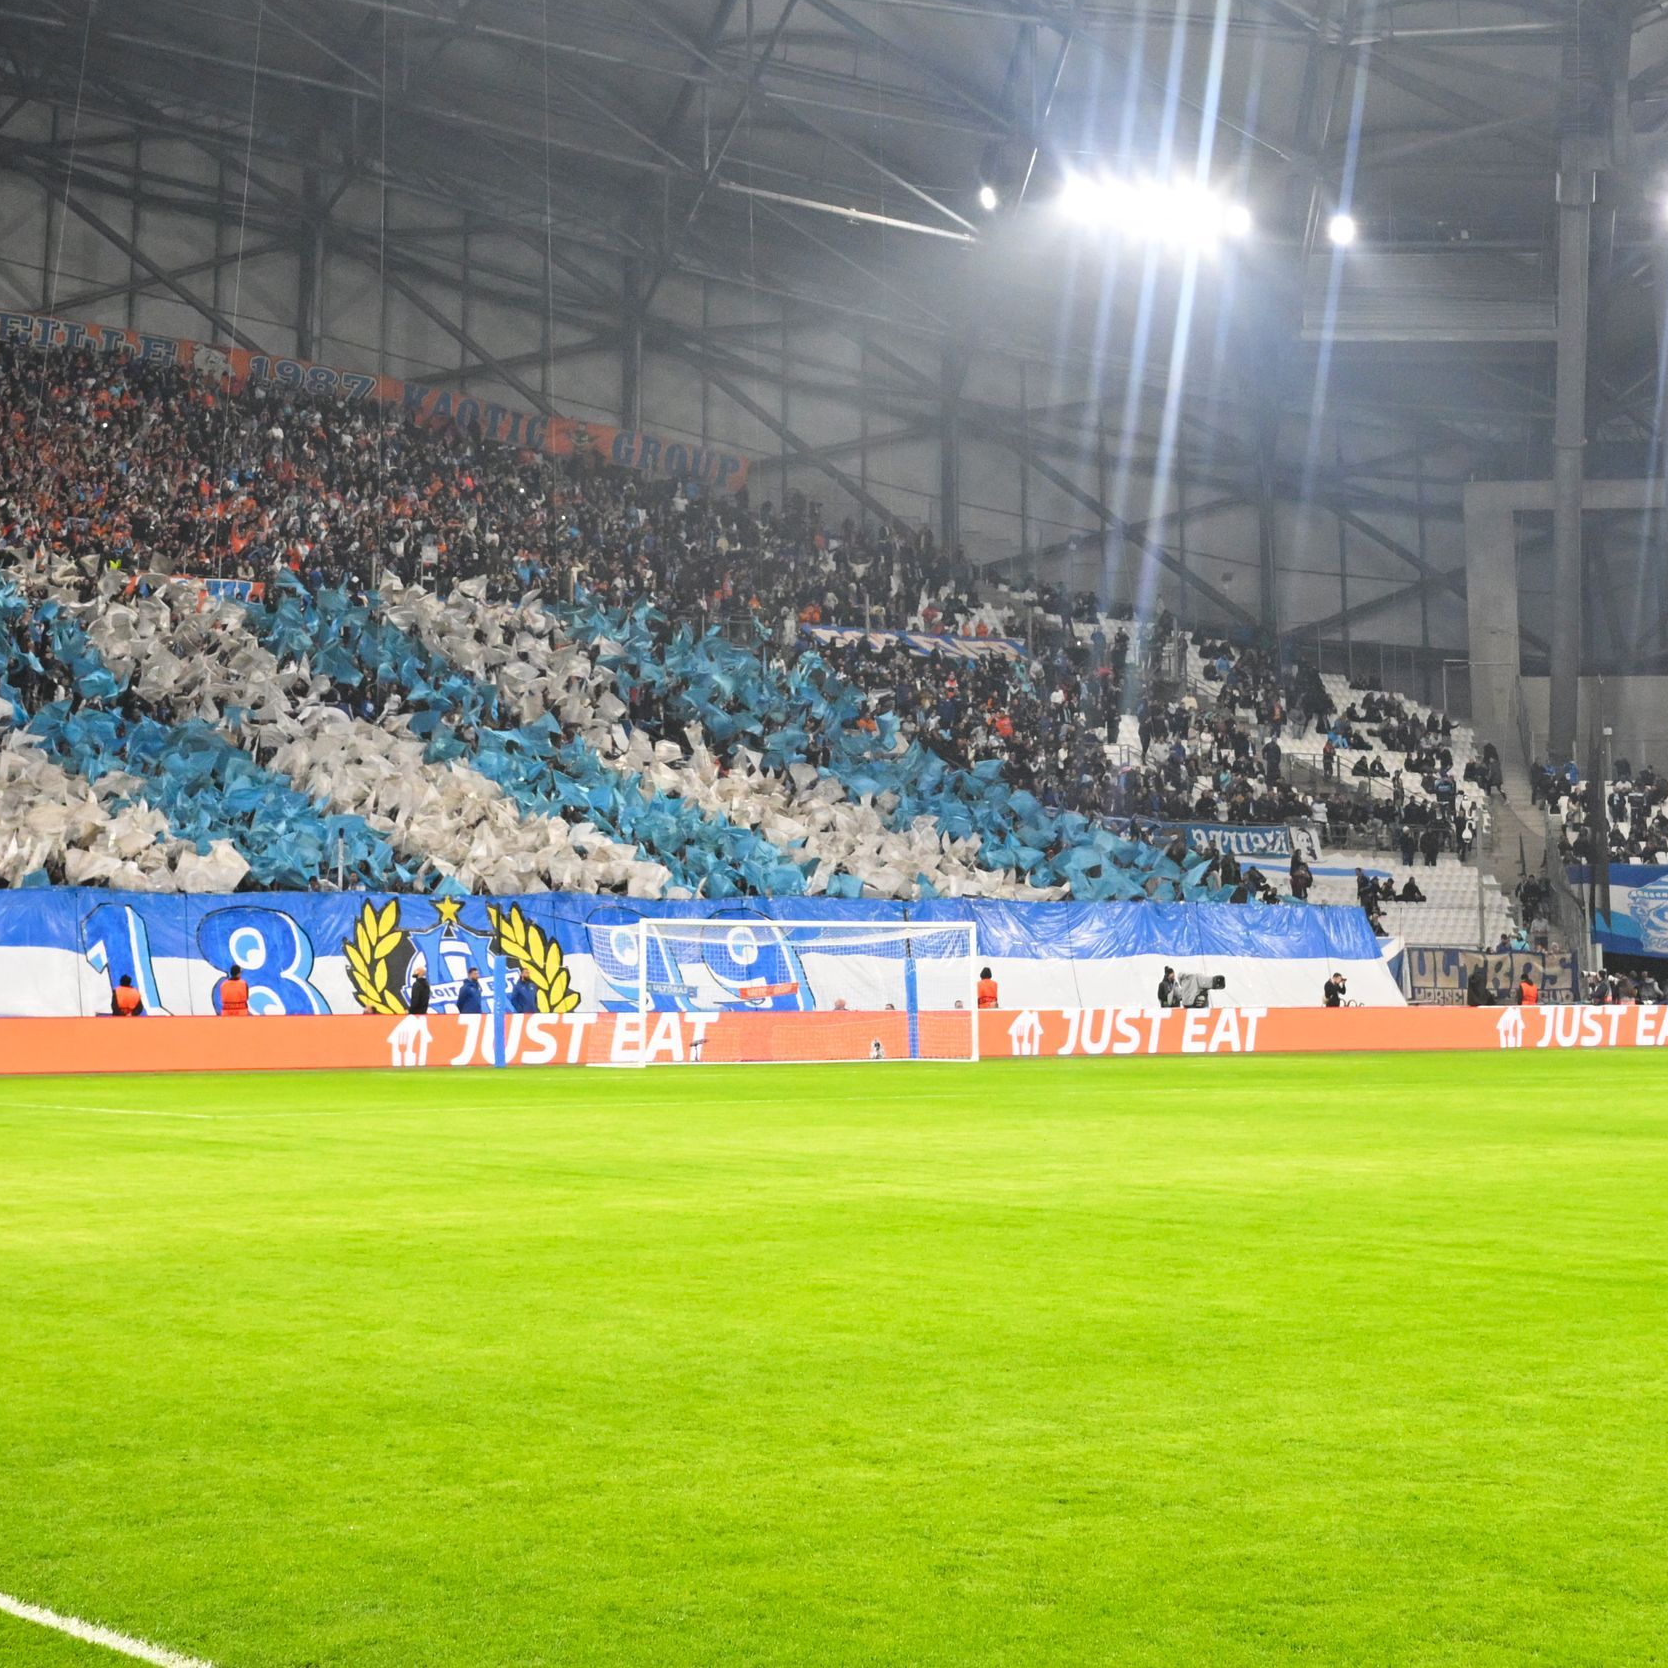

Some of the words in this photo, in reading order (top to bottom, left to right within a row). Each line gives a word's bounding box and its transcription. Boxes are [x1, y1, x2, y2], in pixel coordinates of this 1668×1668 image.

[249, 355, 376, 402] 1987
[612, 428, 741, 486] GROUP
[450, 1012, 598, 1066] JUST
[608, 1011, 720, 1063] EAT
[1057, 1006, 1172, 1056] JUST
[1181, 1006, 1268, 1053] EAT
[1537, 1004, 1628, 1048] JUST
